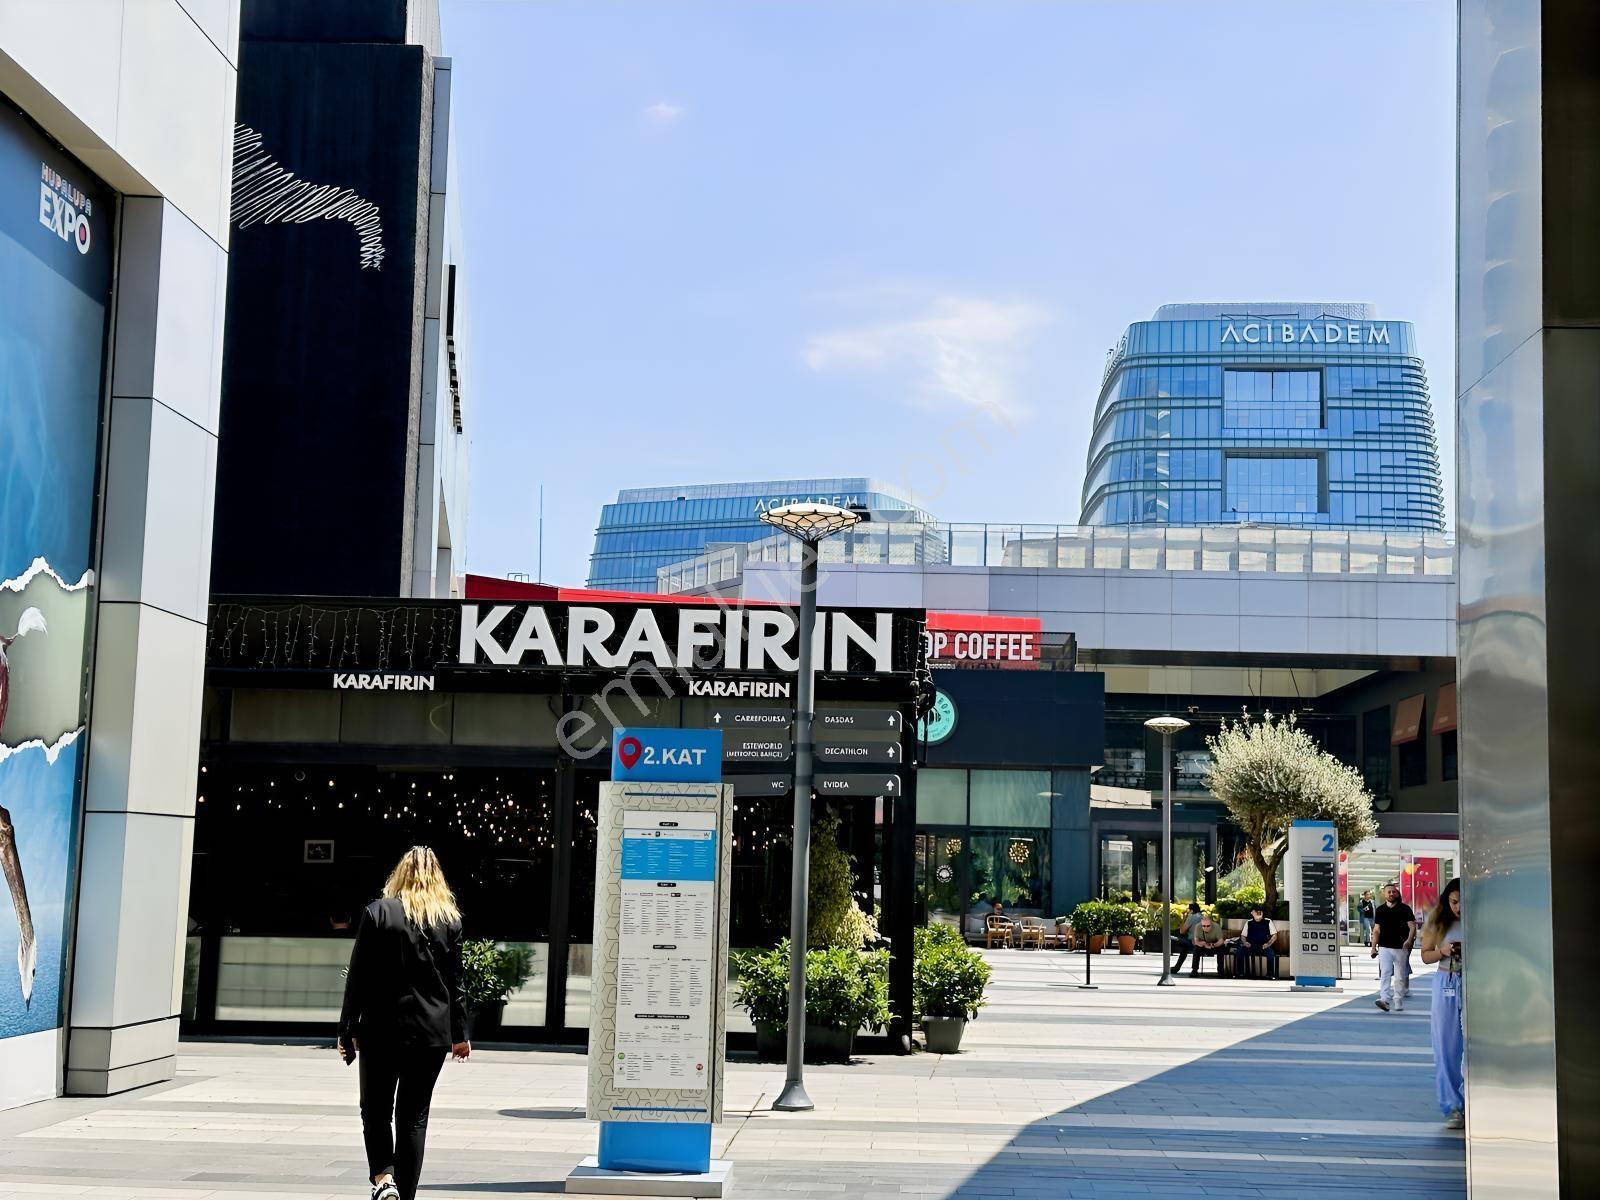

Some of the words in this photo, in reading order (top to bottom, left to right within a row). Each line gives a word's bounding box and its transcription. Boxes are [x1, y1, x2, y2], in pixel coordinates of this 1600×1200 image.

[39, 181, 91, 255] EXPO
[1221, 323, 1390, 345] ACIBADEM
[459, 604, 894, 673] KARAFIRIN
[954, 632, 1034, 661] COFFEE
[333, 673, 435, 691] KARAFIRIN
[689, 681, 790, 698] KARAFIRIN
[735, 715, 786, 723] CARREFOURSA
[825, 716, 854, 724] DASDAS
[743, 742, 783, 750] ESTEWORLD
[825, 748, 868, 756] DECATHLON
[643, 746, 707, 766] 2.KAT
[823, 781, 849, 789] EVIDEA
[1322, 834, 1334, 852] 2
